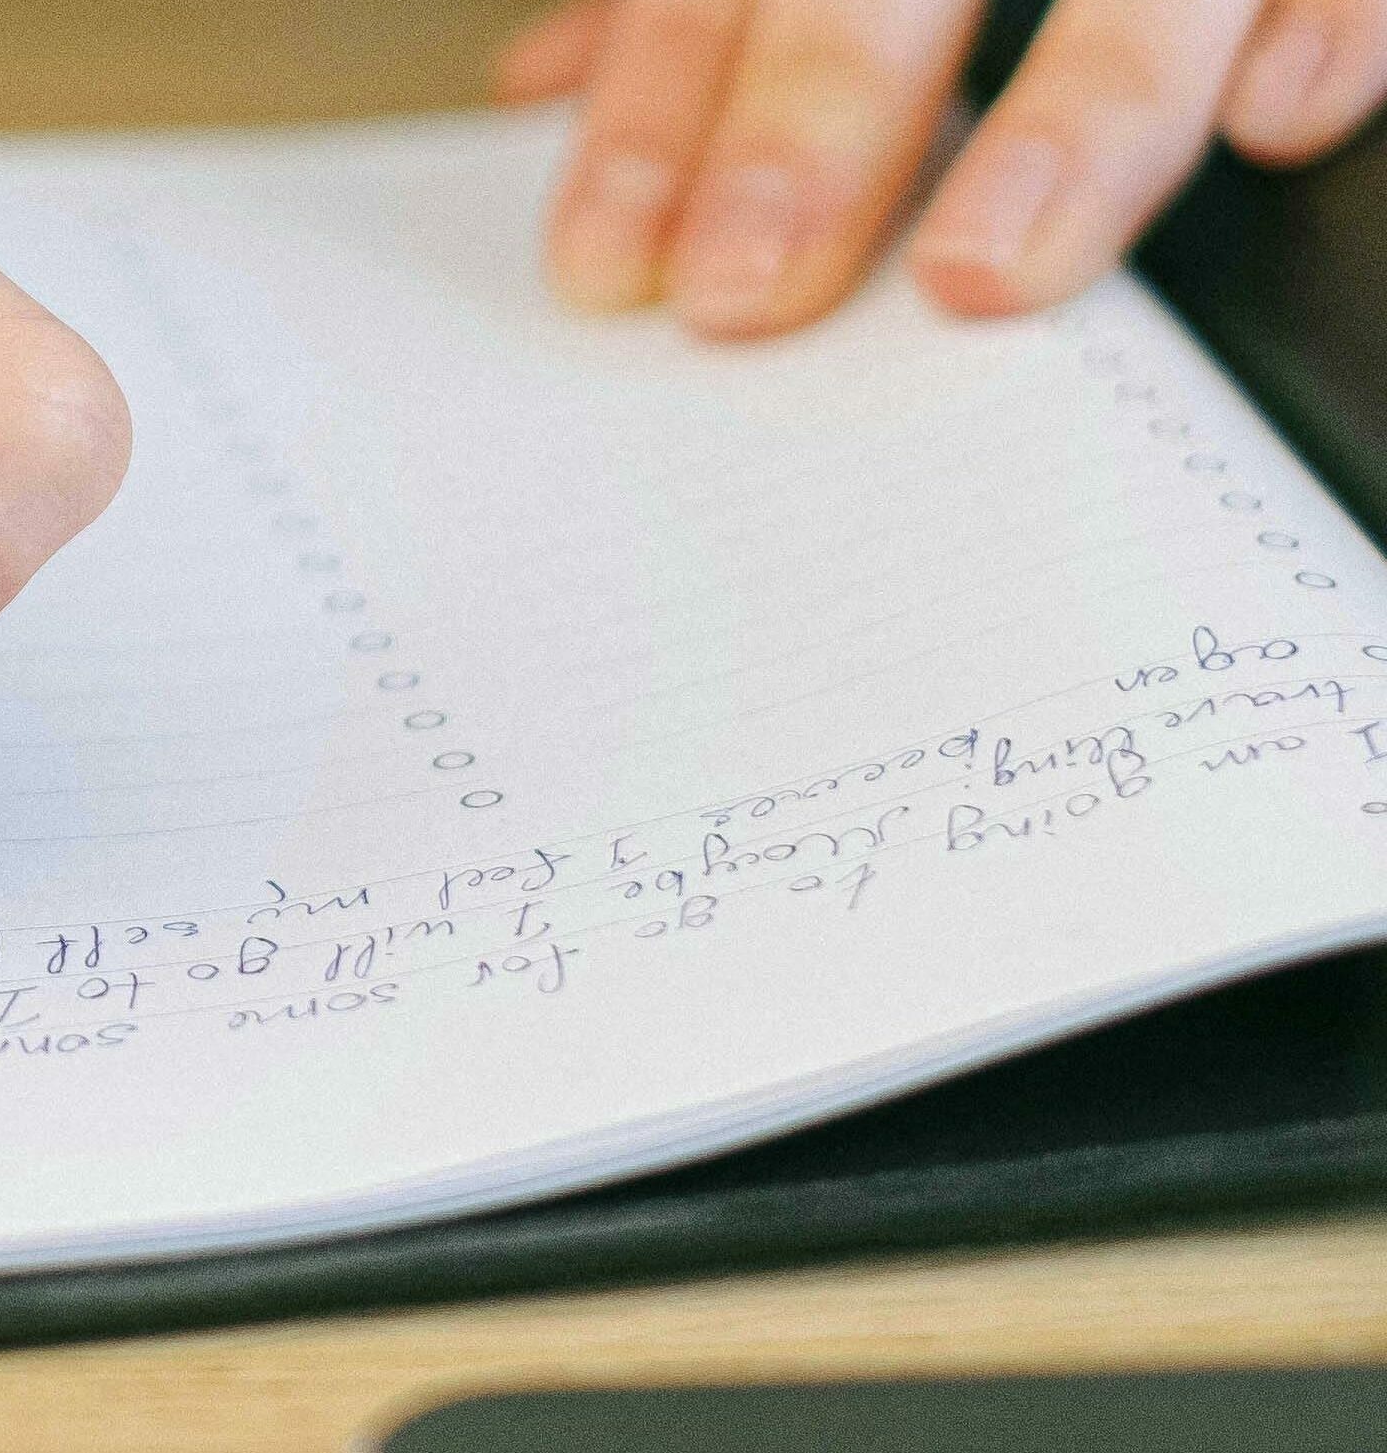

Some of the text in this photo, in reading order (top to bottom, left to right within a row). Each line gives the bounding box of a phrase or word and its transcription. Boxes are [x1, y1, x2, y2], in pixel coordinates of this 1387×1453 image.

[1113, 624, 1298, 692] agen
[1198, 734, 1305, 772] am
[1348, 720, 1387, 765] I
[945, 746, 1151, 852] going
[437, 847, 572, 910] feel
[786, 863, 875, 910] to
[504, 899, 550, 938] I
[633, 894, 718, 939] go
[186, 935, 277, 982] go
[322, 919, 453, 983] will
[465, 943, 579, 994] for
[75, 970, 156, 1010] to
[226, 982, 398, 1030] some
